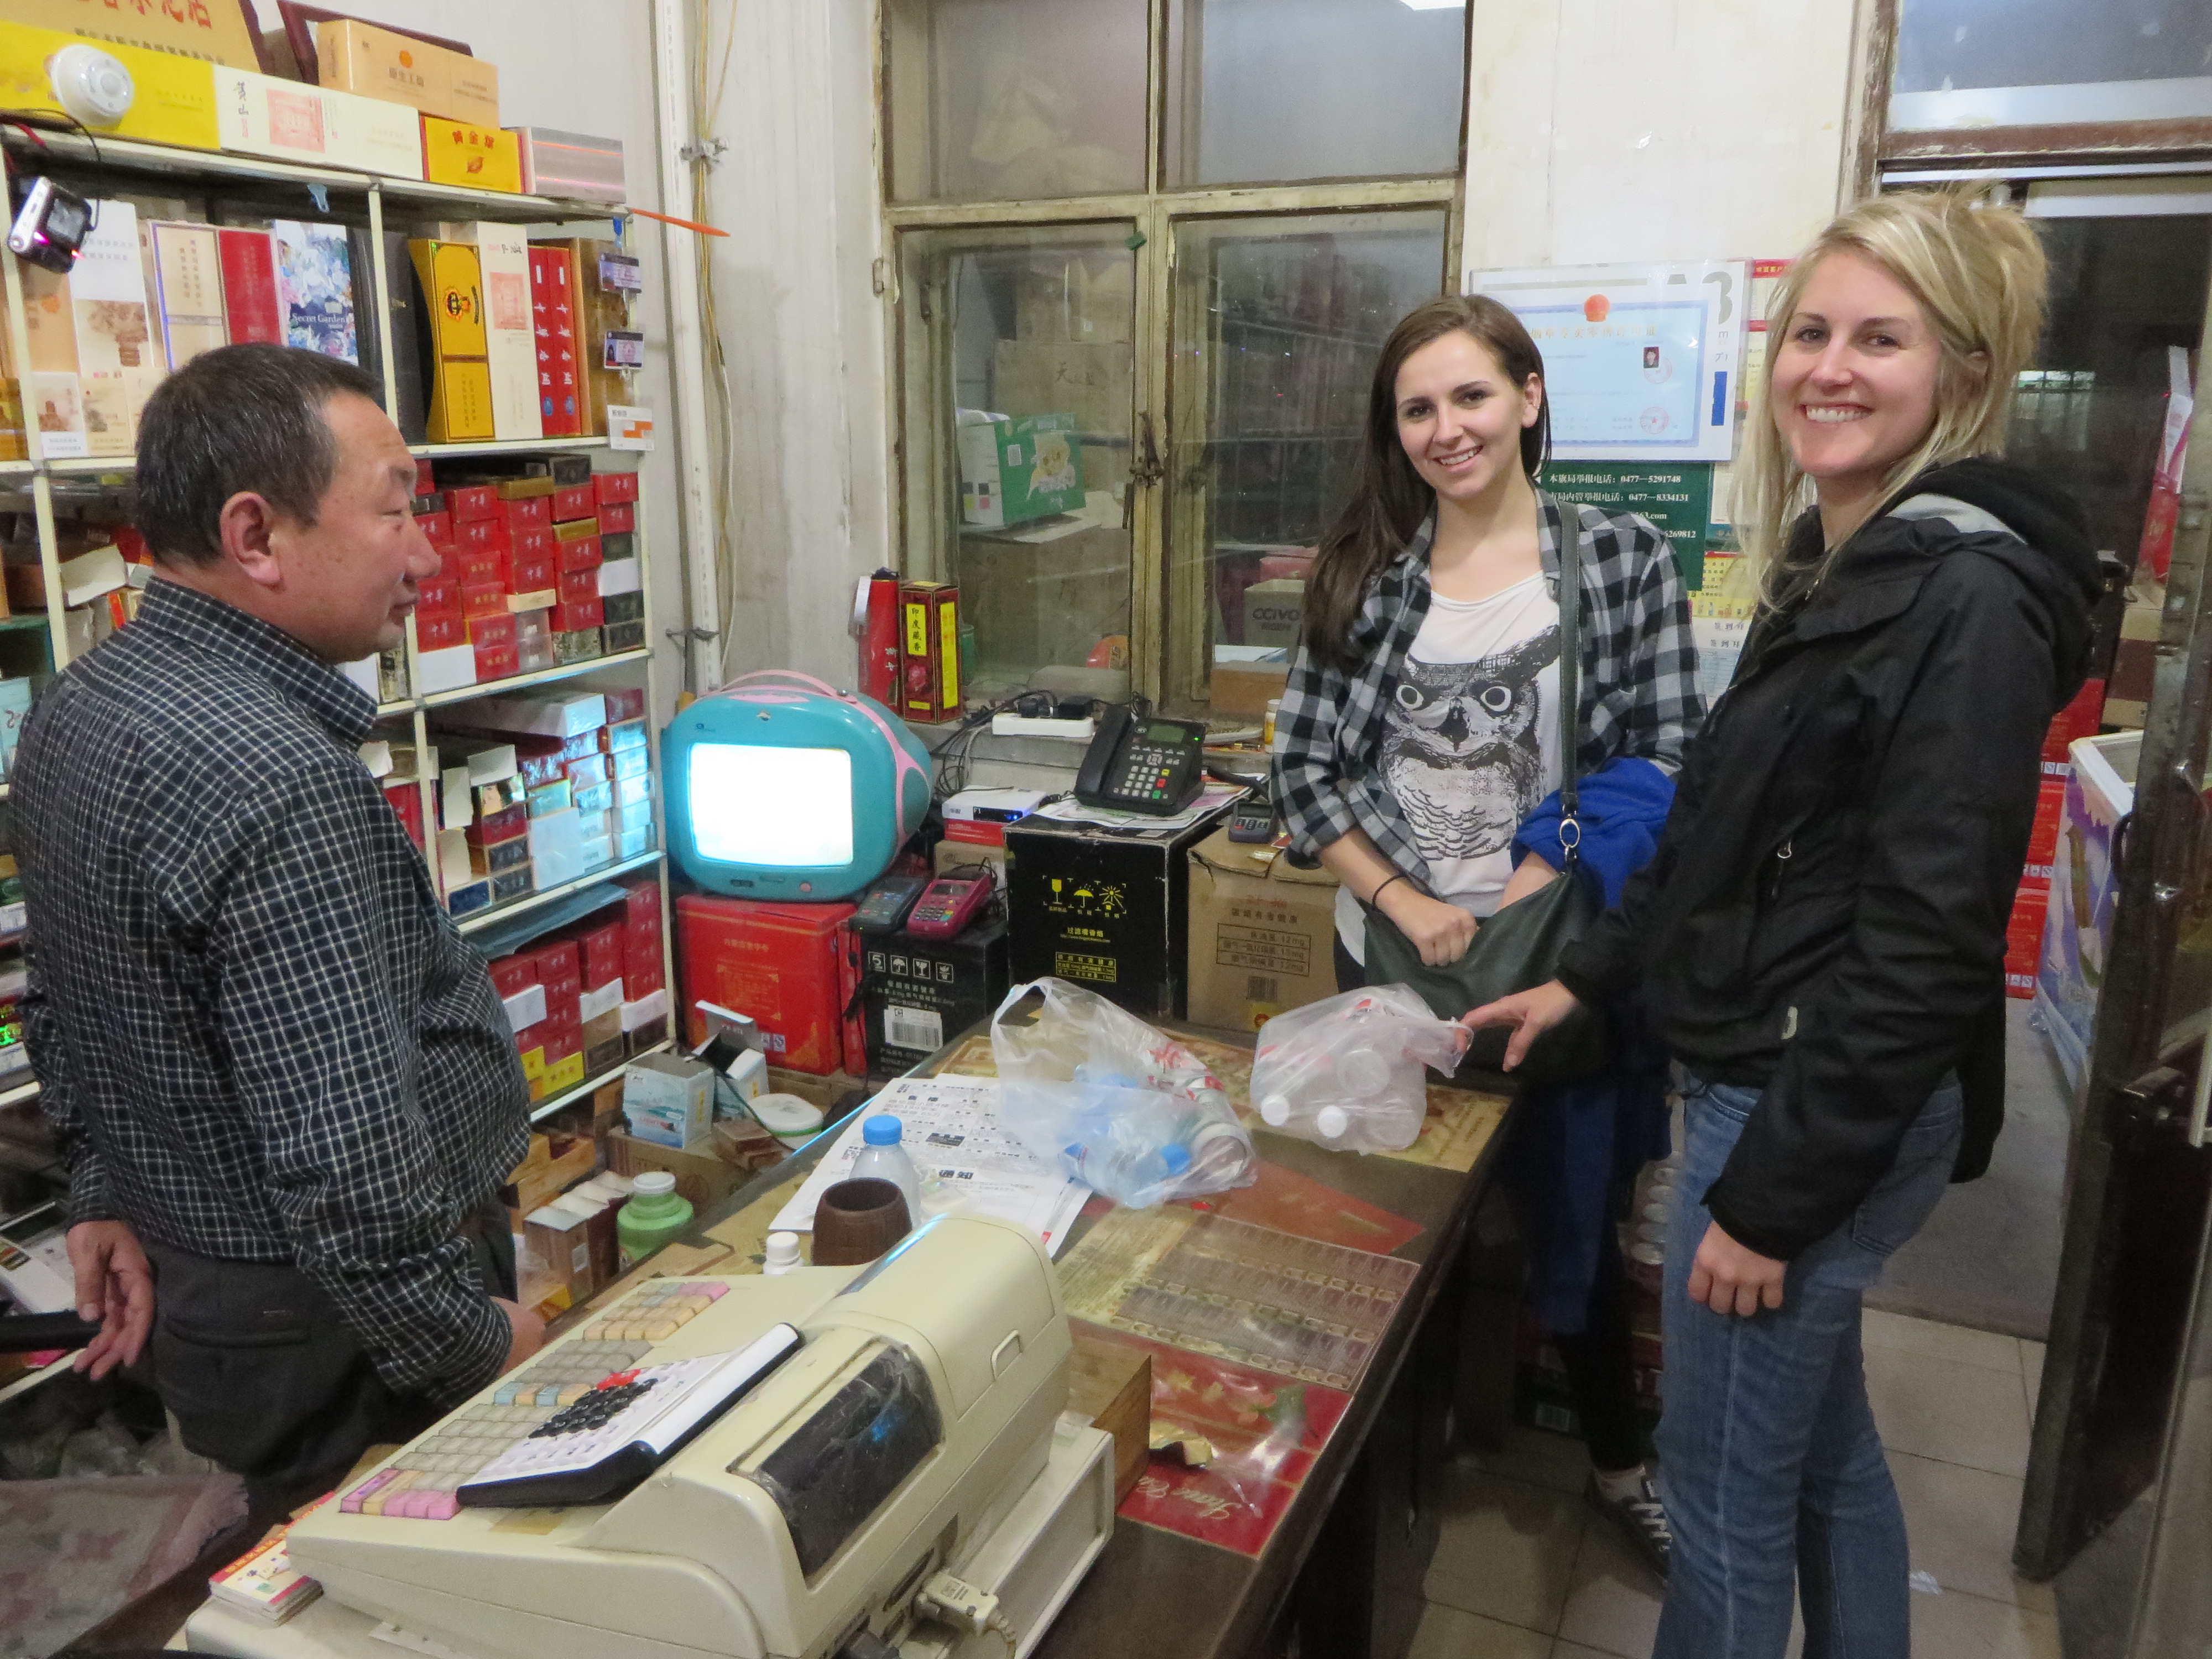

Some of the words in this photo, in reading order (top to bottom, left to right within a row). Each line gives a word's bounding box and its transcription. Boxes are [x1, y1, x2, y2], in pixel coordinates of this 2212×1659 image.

[293, 313, 317, 322] Secret
[318, 314, 345, 324] Garden
[911, 607, 922, 653] 印度藏香
[1232, 907, 1297, 924] 吸烟有害健康
[1067, 927, 1103, 937] 过滤嘴香烟
